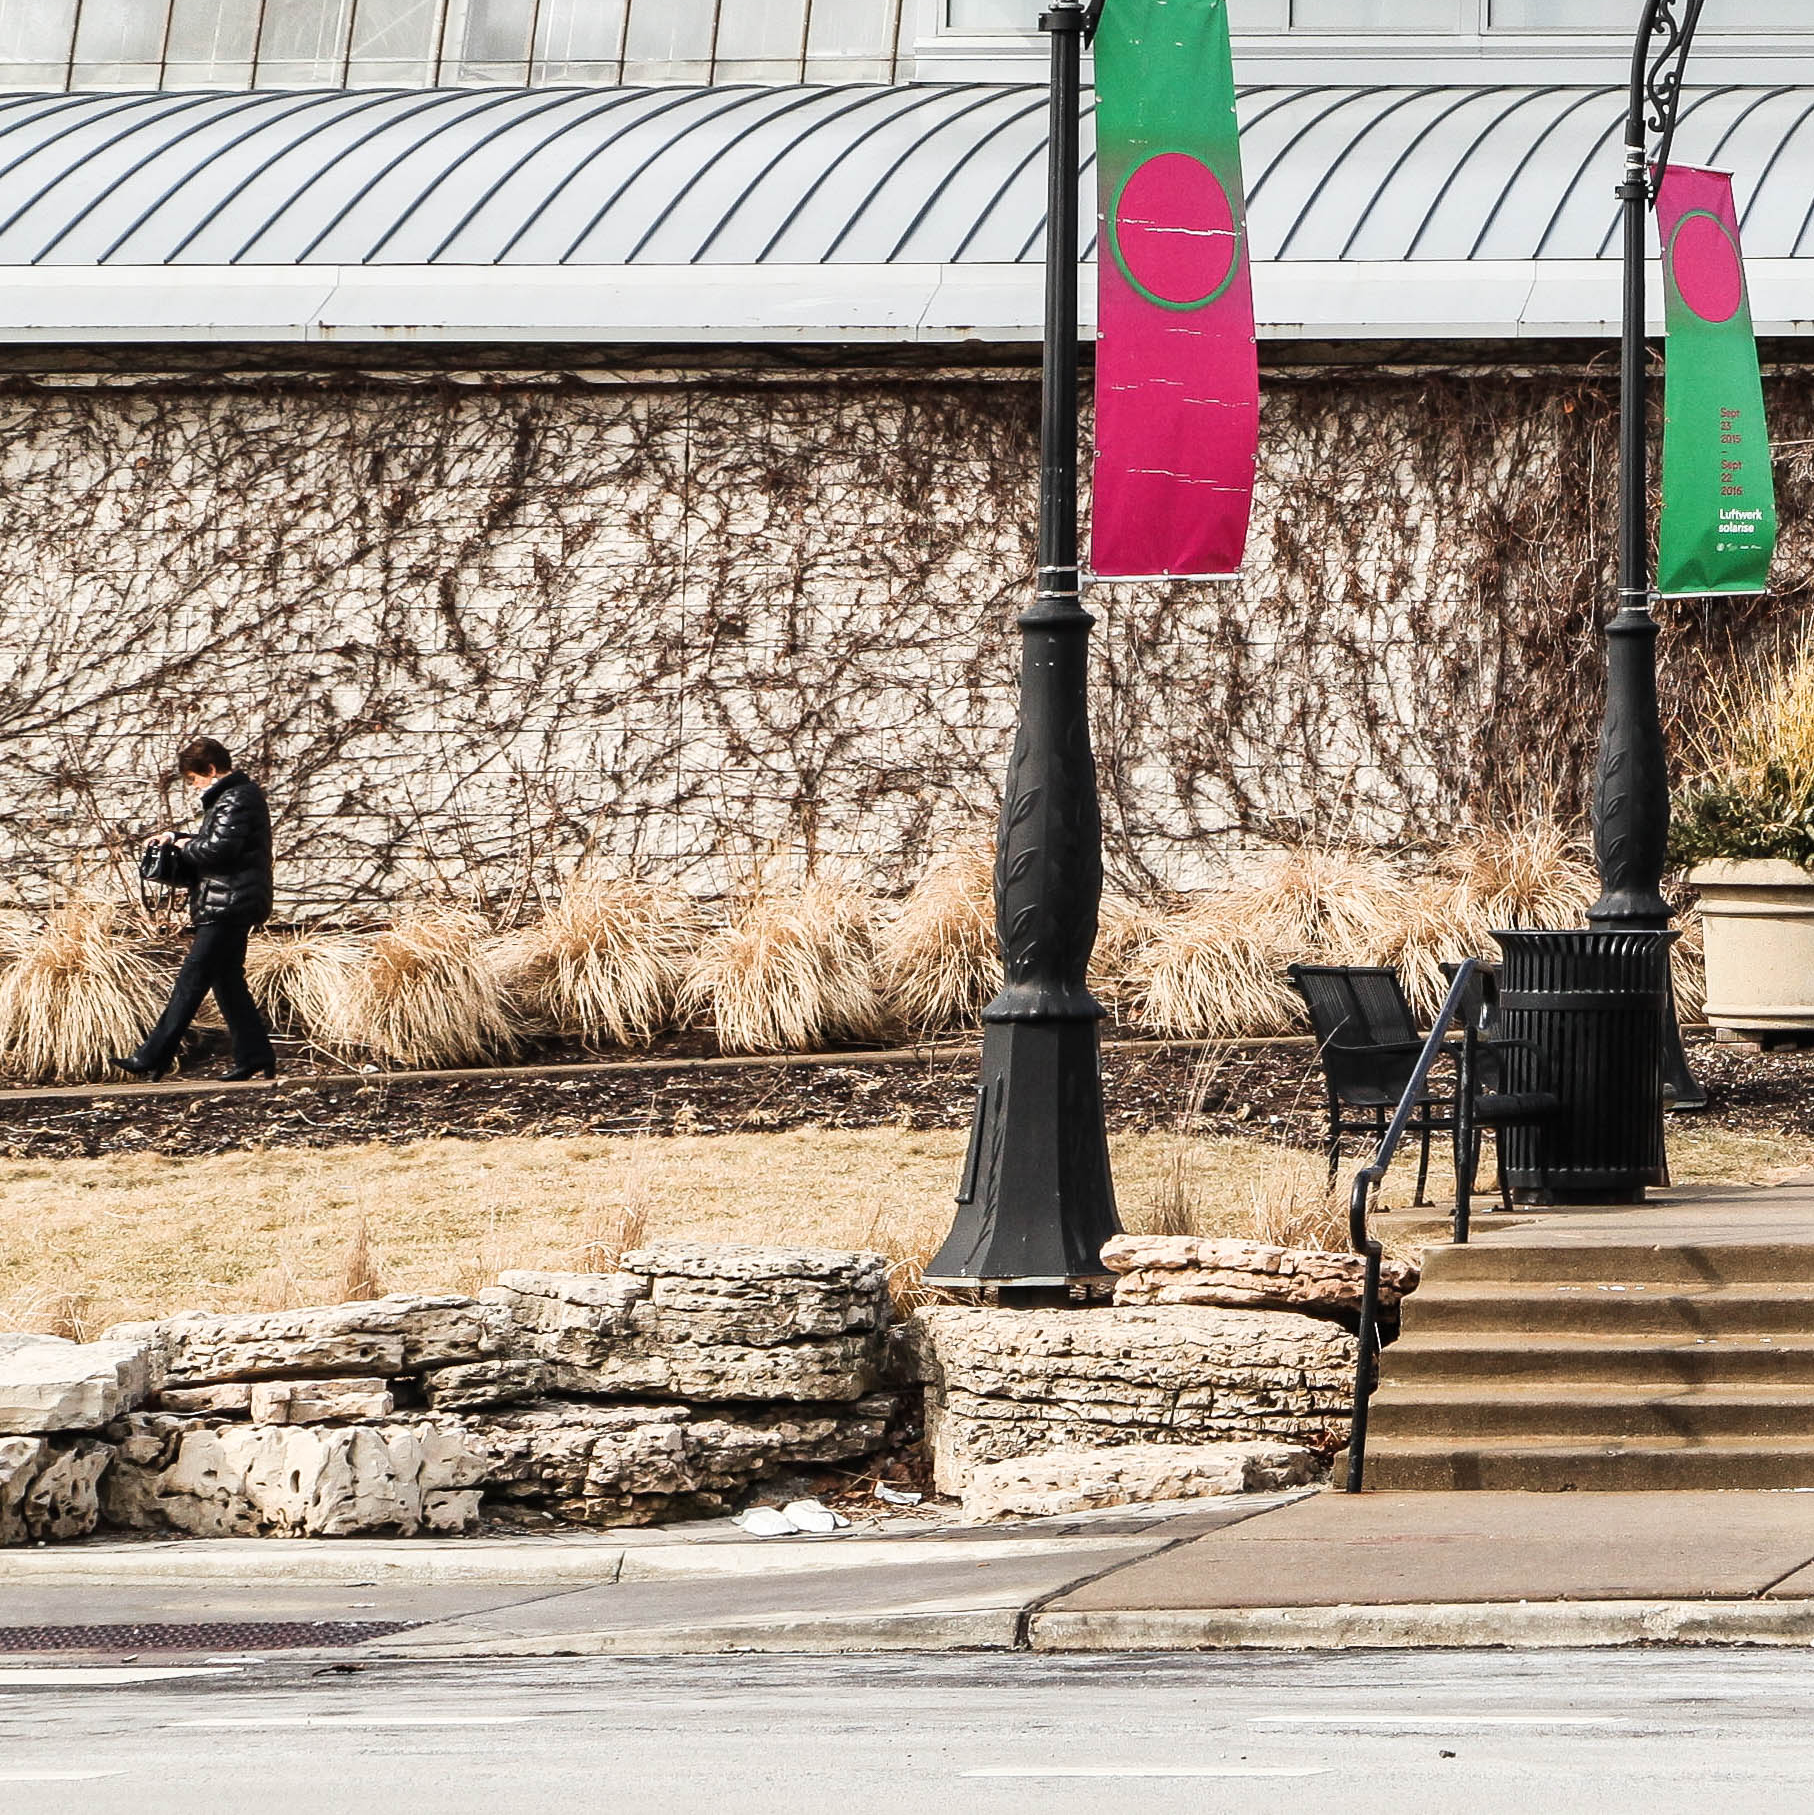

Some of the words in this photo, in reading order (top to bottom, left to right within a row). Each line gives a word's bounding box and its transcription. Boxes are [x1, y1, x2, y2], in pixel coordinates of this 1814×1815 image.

[1720, 407, 1740, 418] Sept
[1721, 459, 1741, 472] Sept
[1721, 473, 1732, 482] 22
[1719, 508, 1763, 520] Luftwerk
[1718, 521, 1754, 533] solarise
